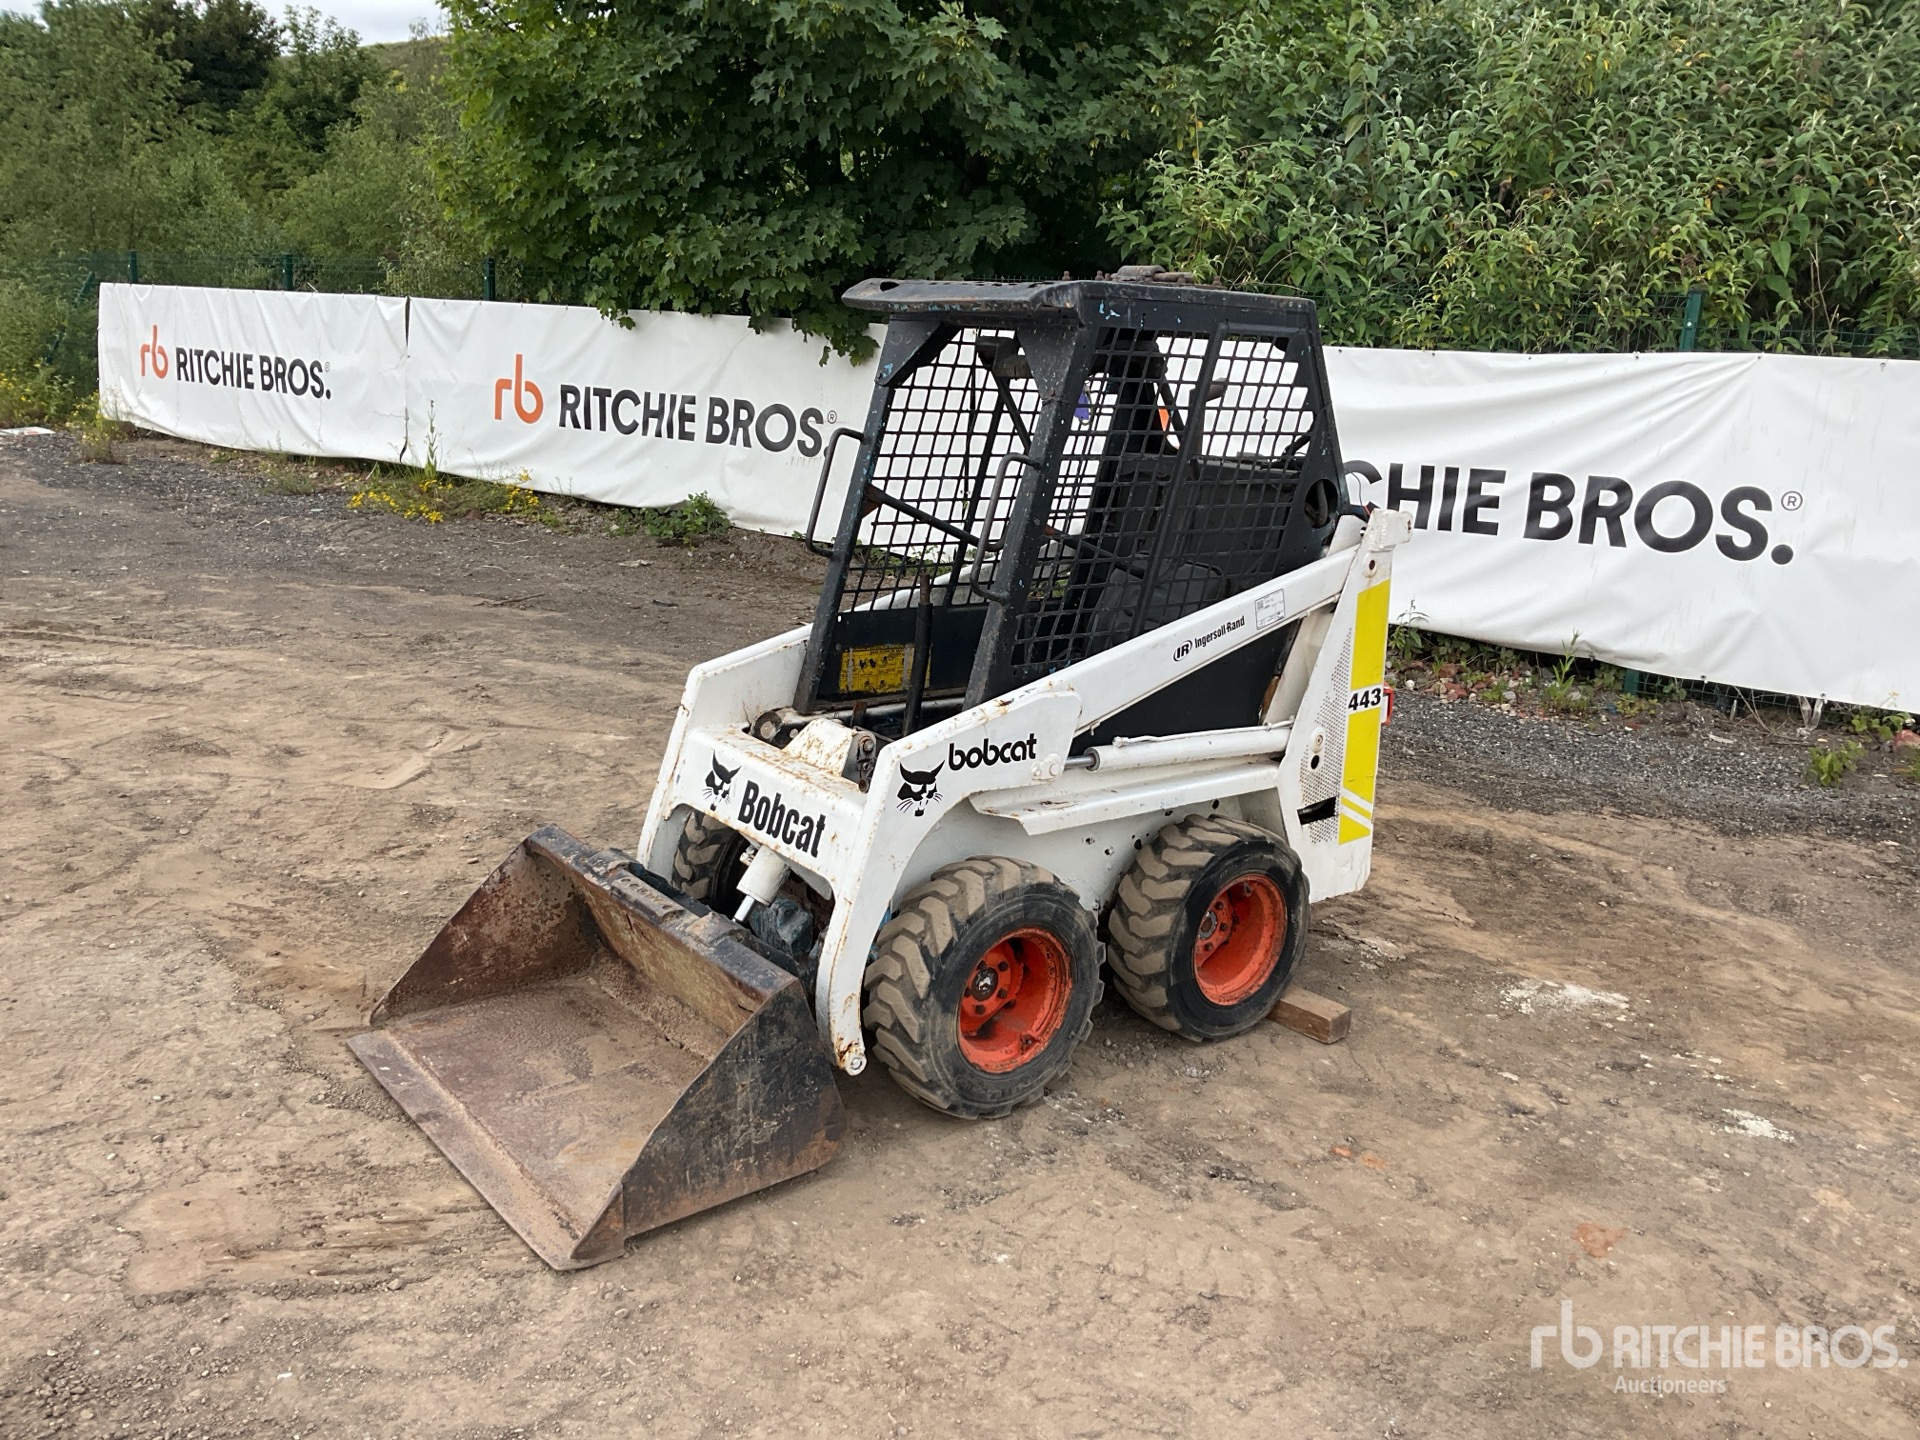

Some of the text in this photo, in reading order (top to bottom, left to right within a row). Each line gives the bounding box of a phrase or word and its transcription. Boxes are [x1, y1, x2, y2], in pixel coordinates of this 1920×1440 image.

[175, 347, 255, 389] RITCHIE
[558, 384, 697, 442] RITCHIE
[1348, 687, 1382, 711] 443
[949, 732, 1037, 771] bobcat
[737, 780, 827, 858] Bobcat
